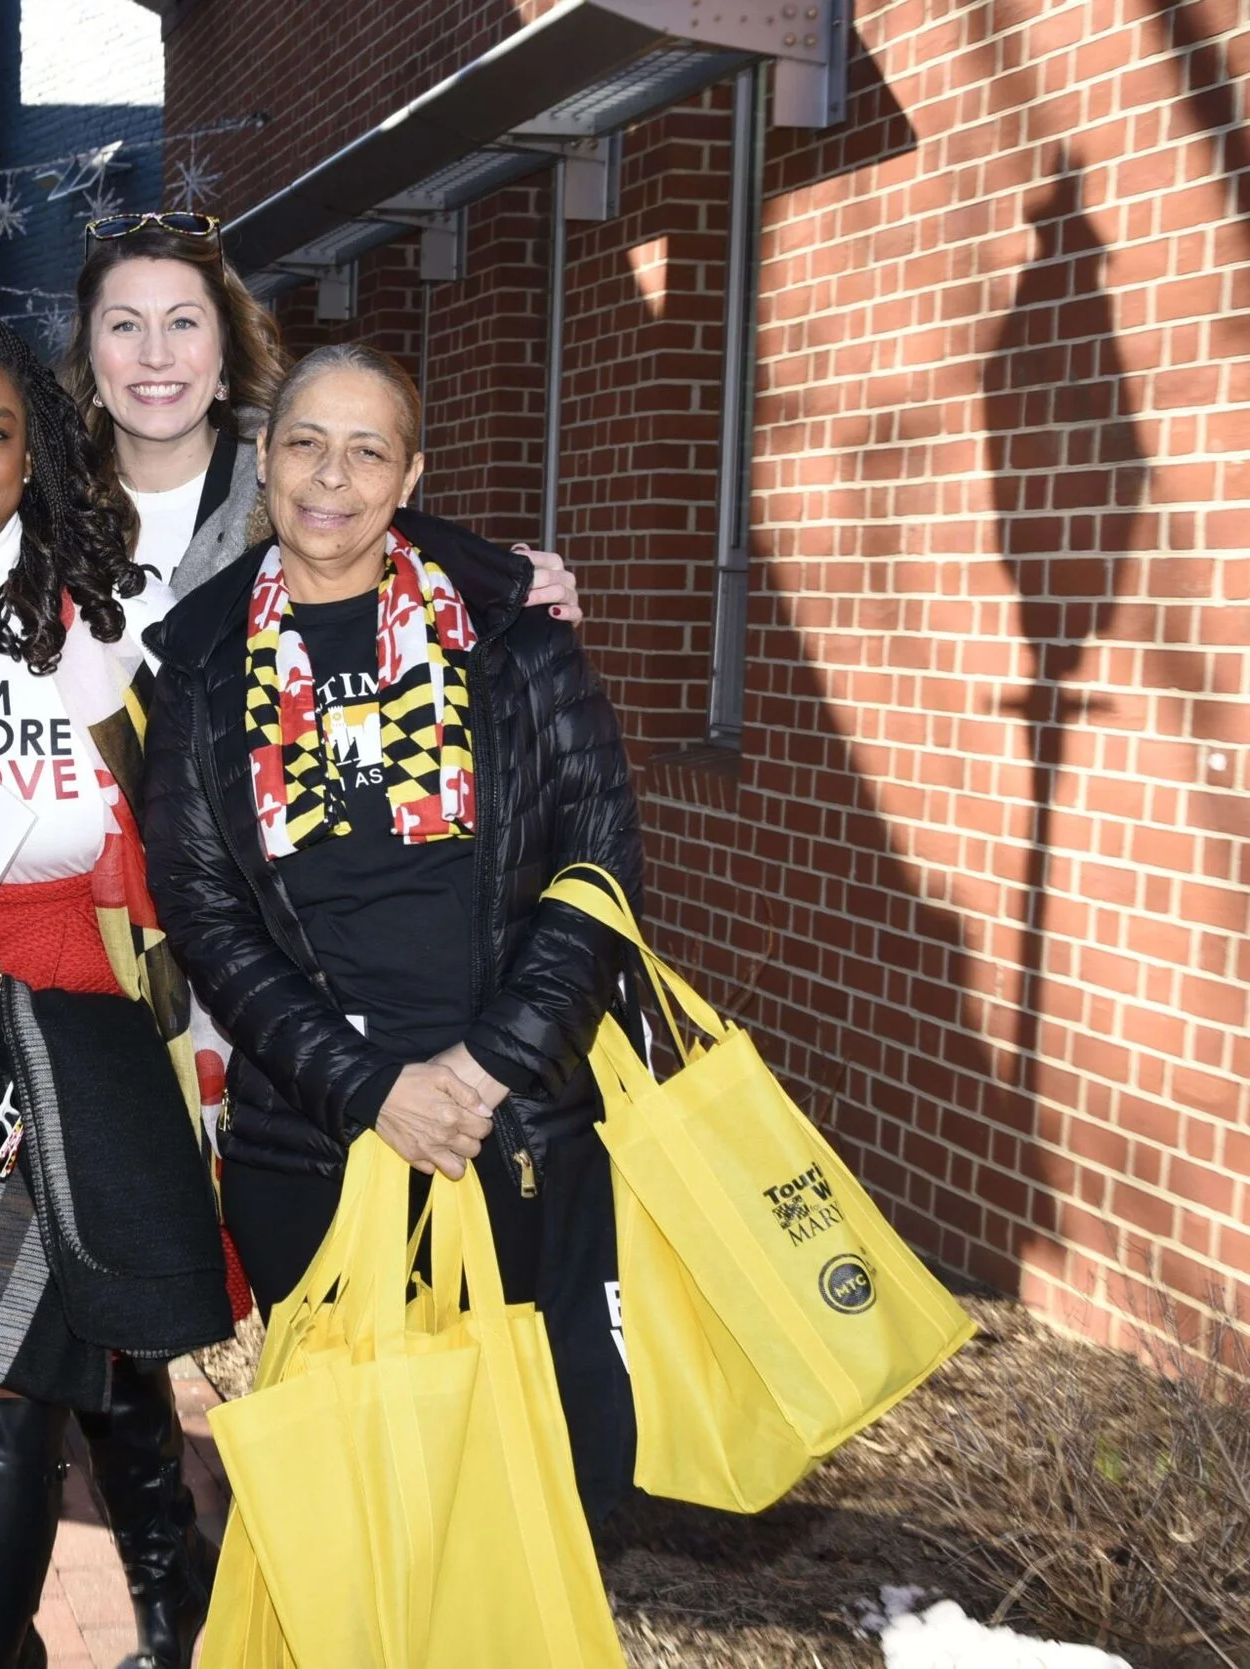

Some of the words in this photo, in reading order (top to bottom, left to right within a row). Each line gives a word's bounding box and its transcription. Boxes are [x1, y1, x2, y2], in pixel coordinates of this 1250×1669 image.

[762, 1161, 824, 1205] Touri
[787, 1199, 844, 1248] MARY
[834, 1273, 867, 1298] MTC
